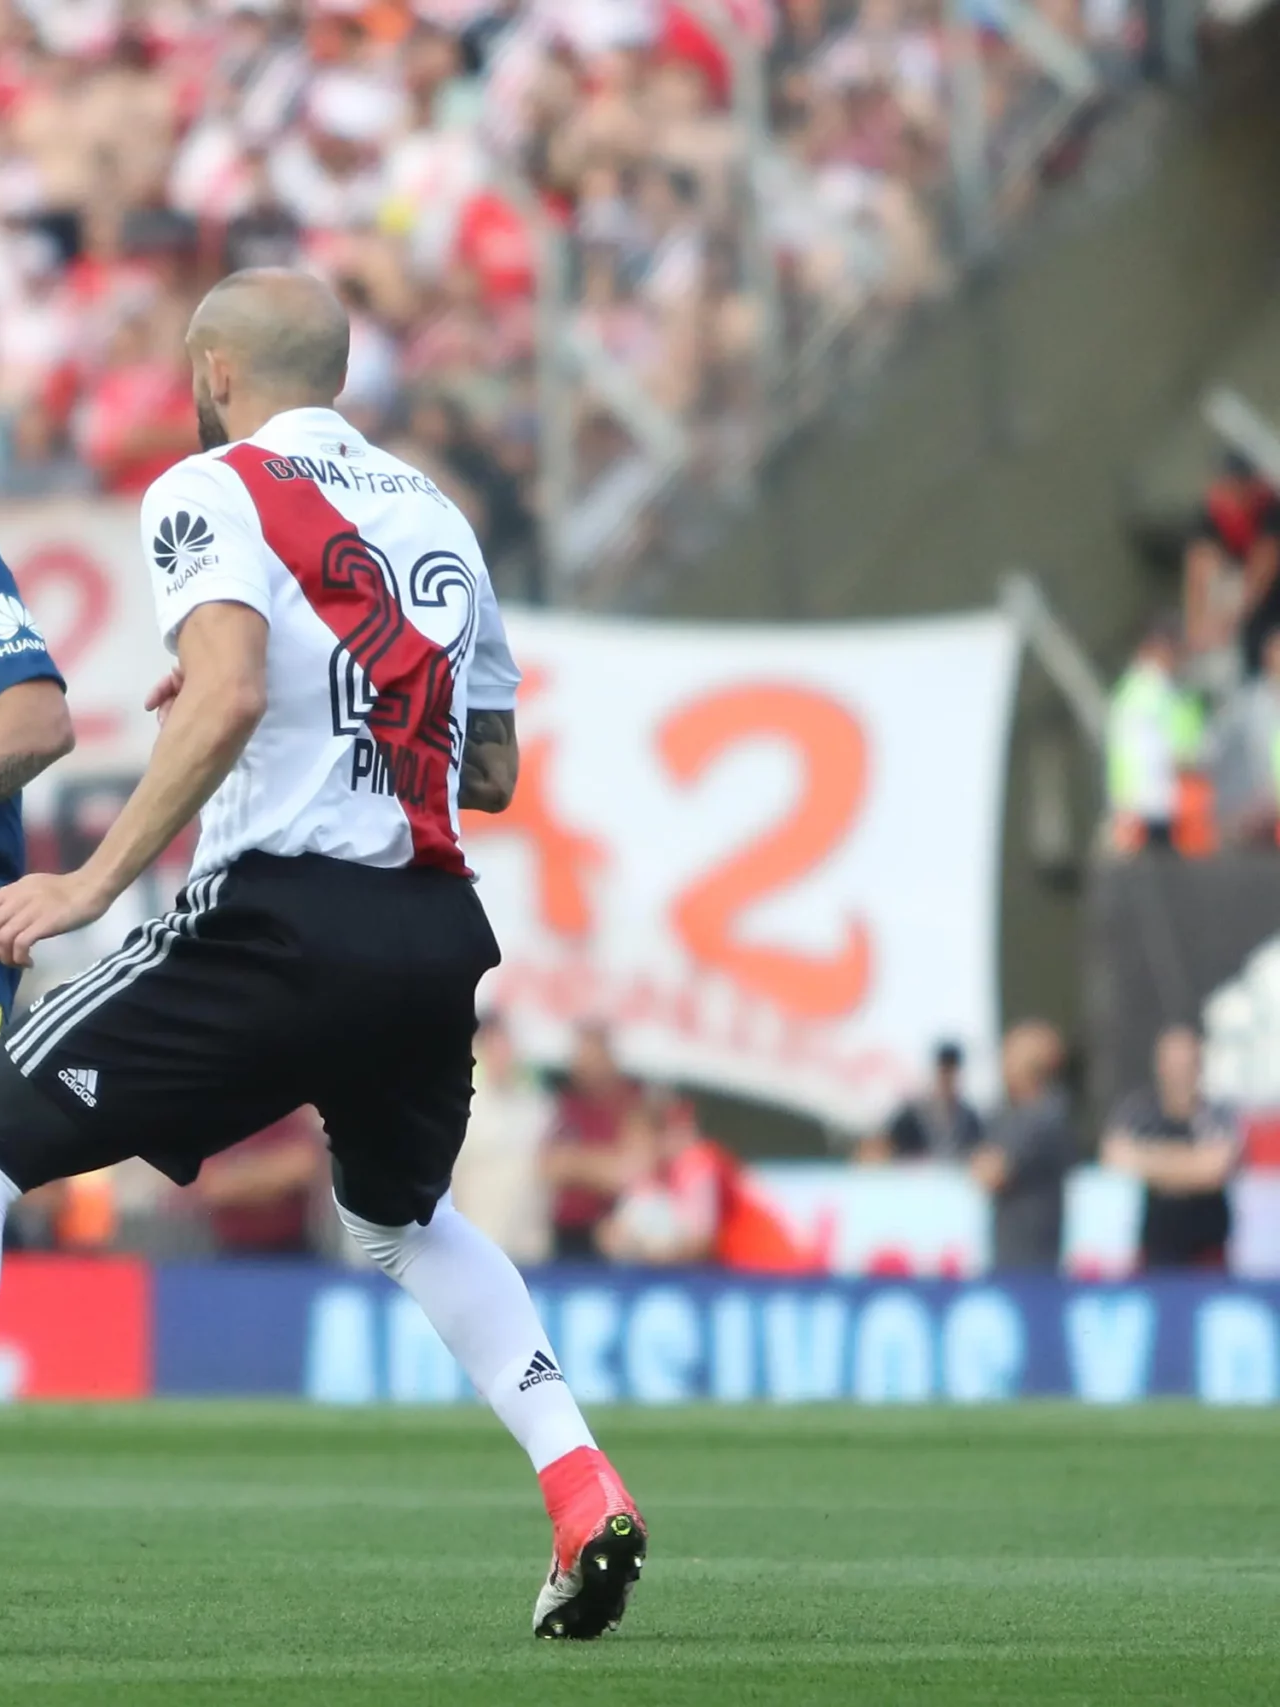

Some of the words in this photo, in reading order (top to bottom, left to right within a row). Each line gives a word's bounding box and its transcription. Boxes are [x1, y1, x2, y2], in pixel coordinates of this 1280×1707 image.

[263, 456, 350, 489] BBVA
[347, 465, 447, 508] Franc
[166, 554, 219, 597] HUAWEI
[58, 1070, 97, 1107] adidas
[518, 1369, 565, 1392] adida
